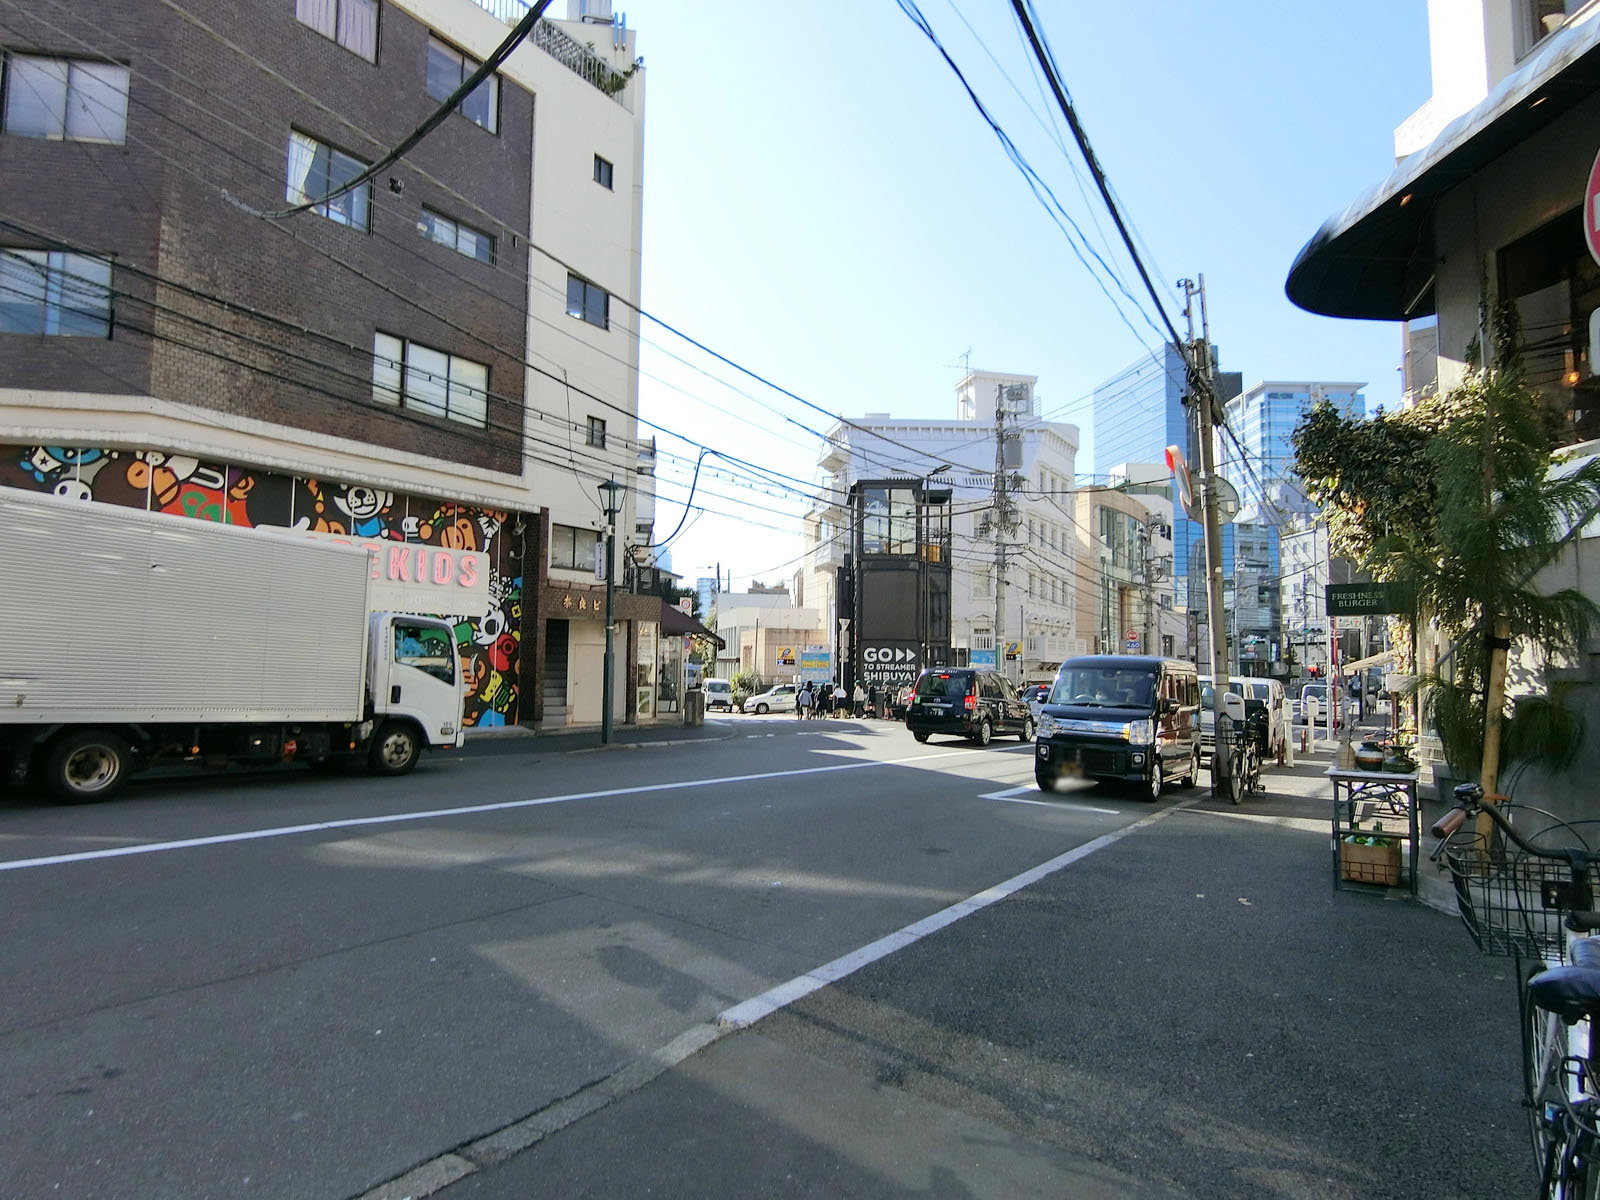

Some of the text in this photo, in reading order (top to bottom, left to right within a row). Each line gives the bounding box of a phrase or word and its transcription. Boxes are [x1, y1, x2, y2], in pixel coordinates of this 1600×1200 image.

[1331, 591, 1384, 600] FRESHNESS
[562, 594, 602, 611] 奈良ビ
[1338, 599, 1378, 607] BURGER
[863, 647, 893, 663] GO
[875, 663, 916, 671] STREAMER
[863, 671, 916, 681] SHIBUYA!
